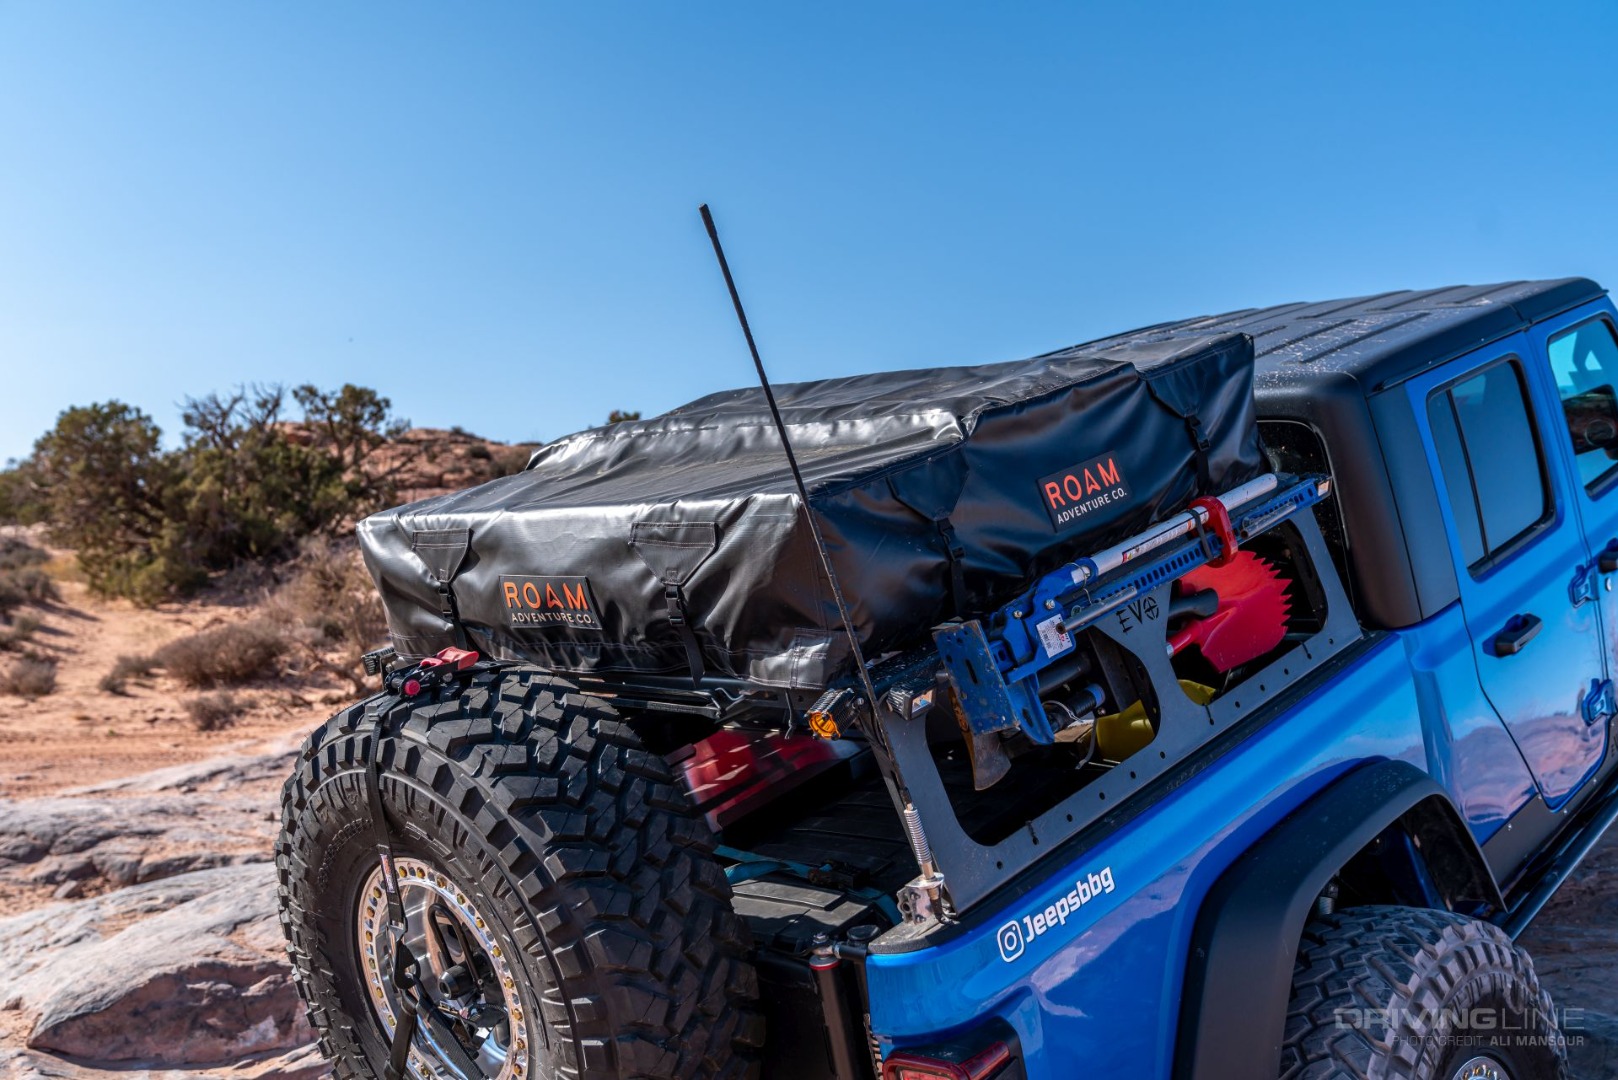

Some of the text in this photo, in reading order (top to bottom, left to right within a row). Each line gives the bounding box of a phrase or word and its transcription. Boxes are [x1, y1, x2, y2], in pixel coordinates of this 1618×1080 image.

[1044, 458, 1121, 510] ROAM
[1057, 487, 1128, 525] ADVENTURE CO.
[503, 581, 589, 610] ROAM
[511, 612, 596, 624] ADVENTURE CO.
[1022, 866, 1116, 943] Jeepsbbg
